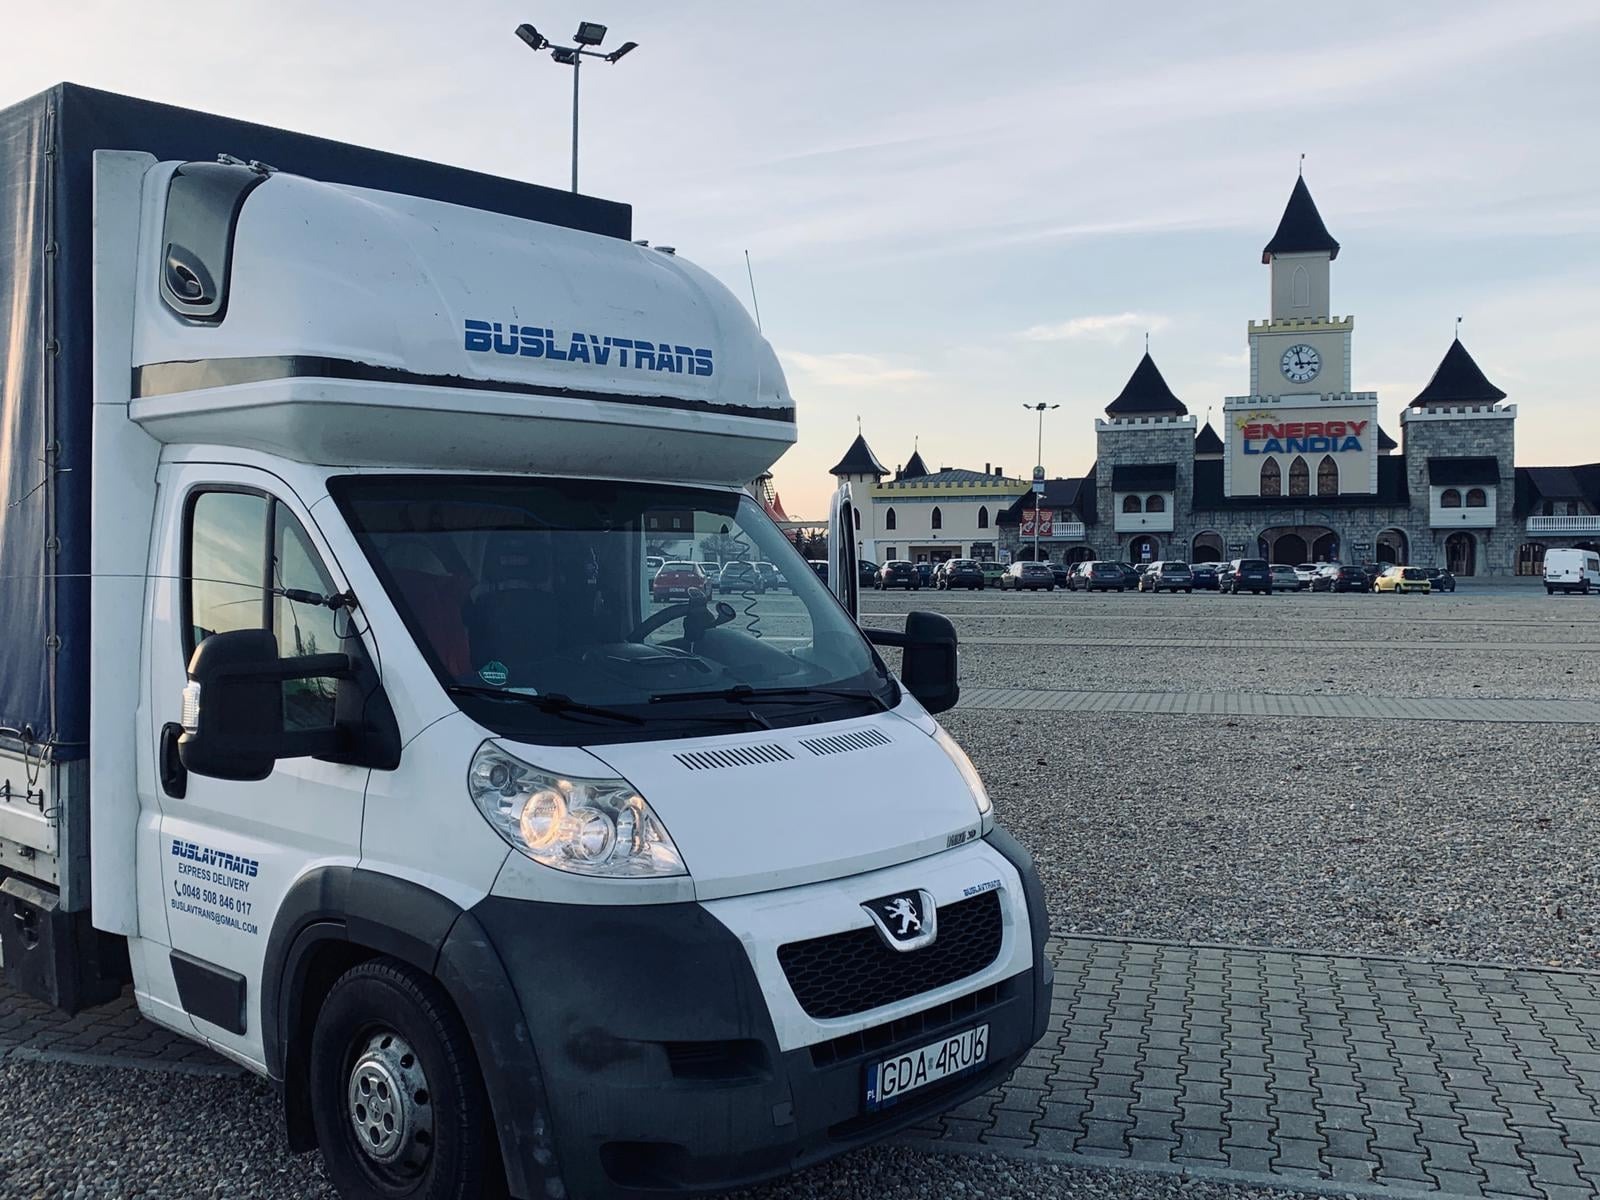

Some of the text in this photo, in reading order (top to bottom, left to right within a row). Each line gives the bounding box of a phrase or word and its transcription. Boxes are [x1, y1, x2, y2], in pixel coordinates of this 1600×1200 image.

[464, 319, 713, 376] BUSLAVTRANS
[1244, 420, 1368, 440] ENERGY
[1244, 436, 1363, 455] LANDIA
[172, 840, 259, 877] BUSLAVTRANS
[178, 862, 250, 892] EXPRESS DELIVERY
[171, 898, 258, 935] BUSLAVTRANS@GMAIL.COM
[182, 883, 252, 916] 0048 508 846 017
[881, 1028, 985, 1096] GDA 4RU6
